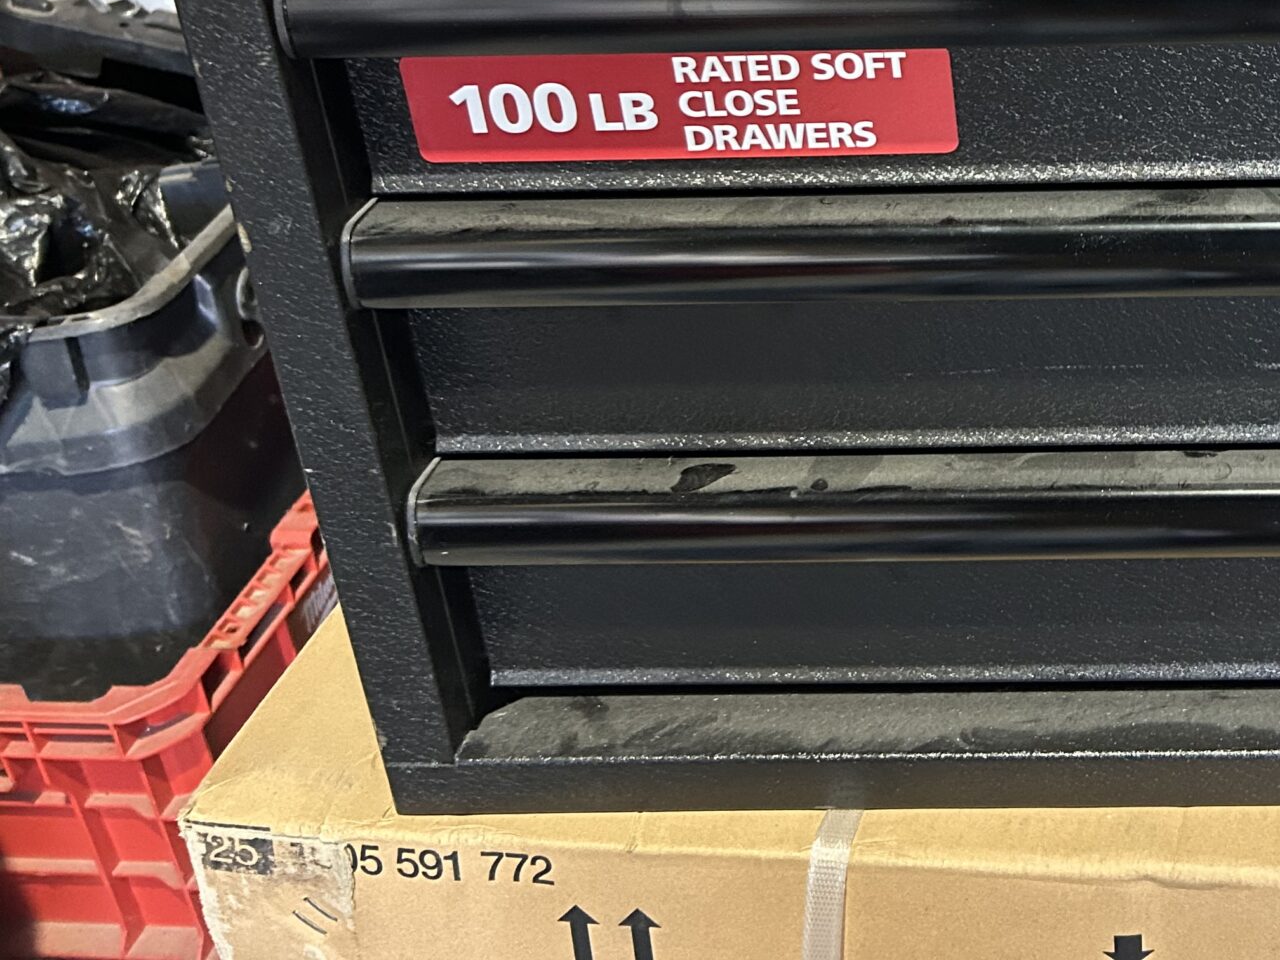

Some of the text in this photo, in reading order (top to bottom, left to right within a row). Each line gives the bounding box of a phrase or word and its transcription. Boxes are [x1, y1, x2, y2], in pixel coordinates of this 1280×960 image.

[671, 51, 907, 83] RATED SOFT
[448, 82, 659, 134] 100 LB
[678, 88, 801, 118] CLOSE
[683, 120, 877, 152] DRAWERS
[396, 847, 461, 881] 591
[480, 851, 555, 886] 772
